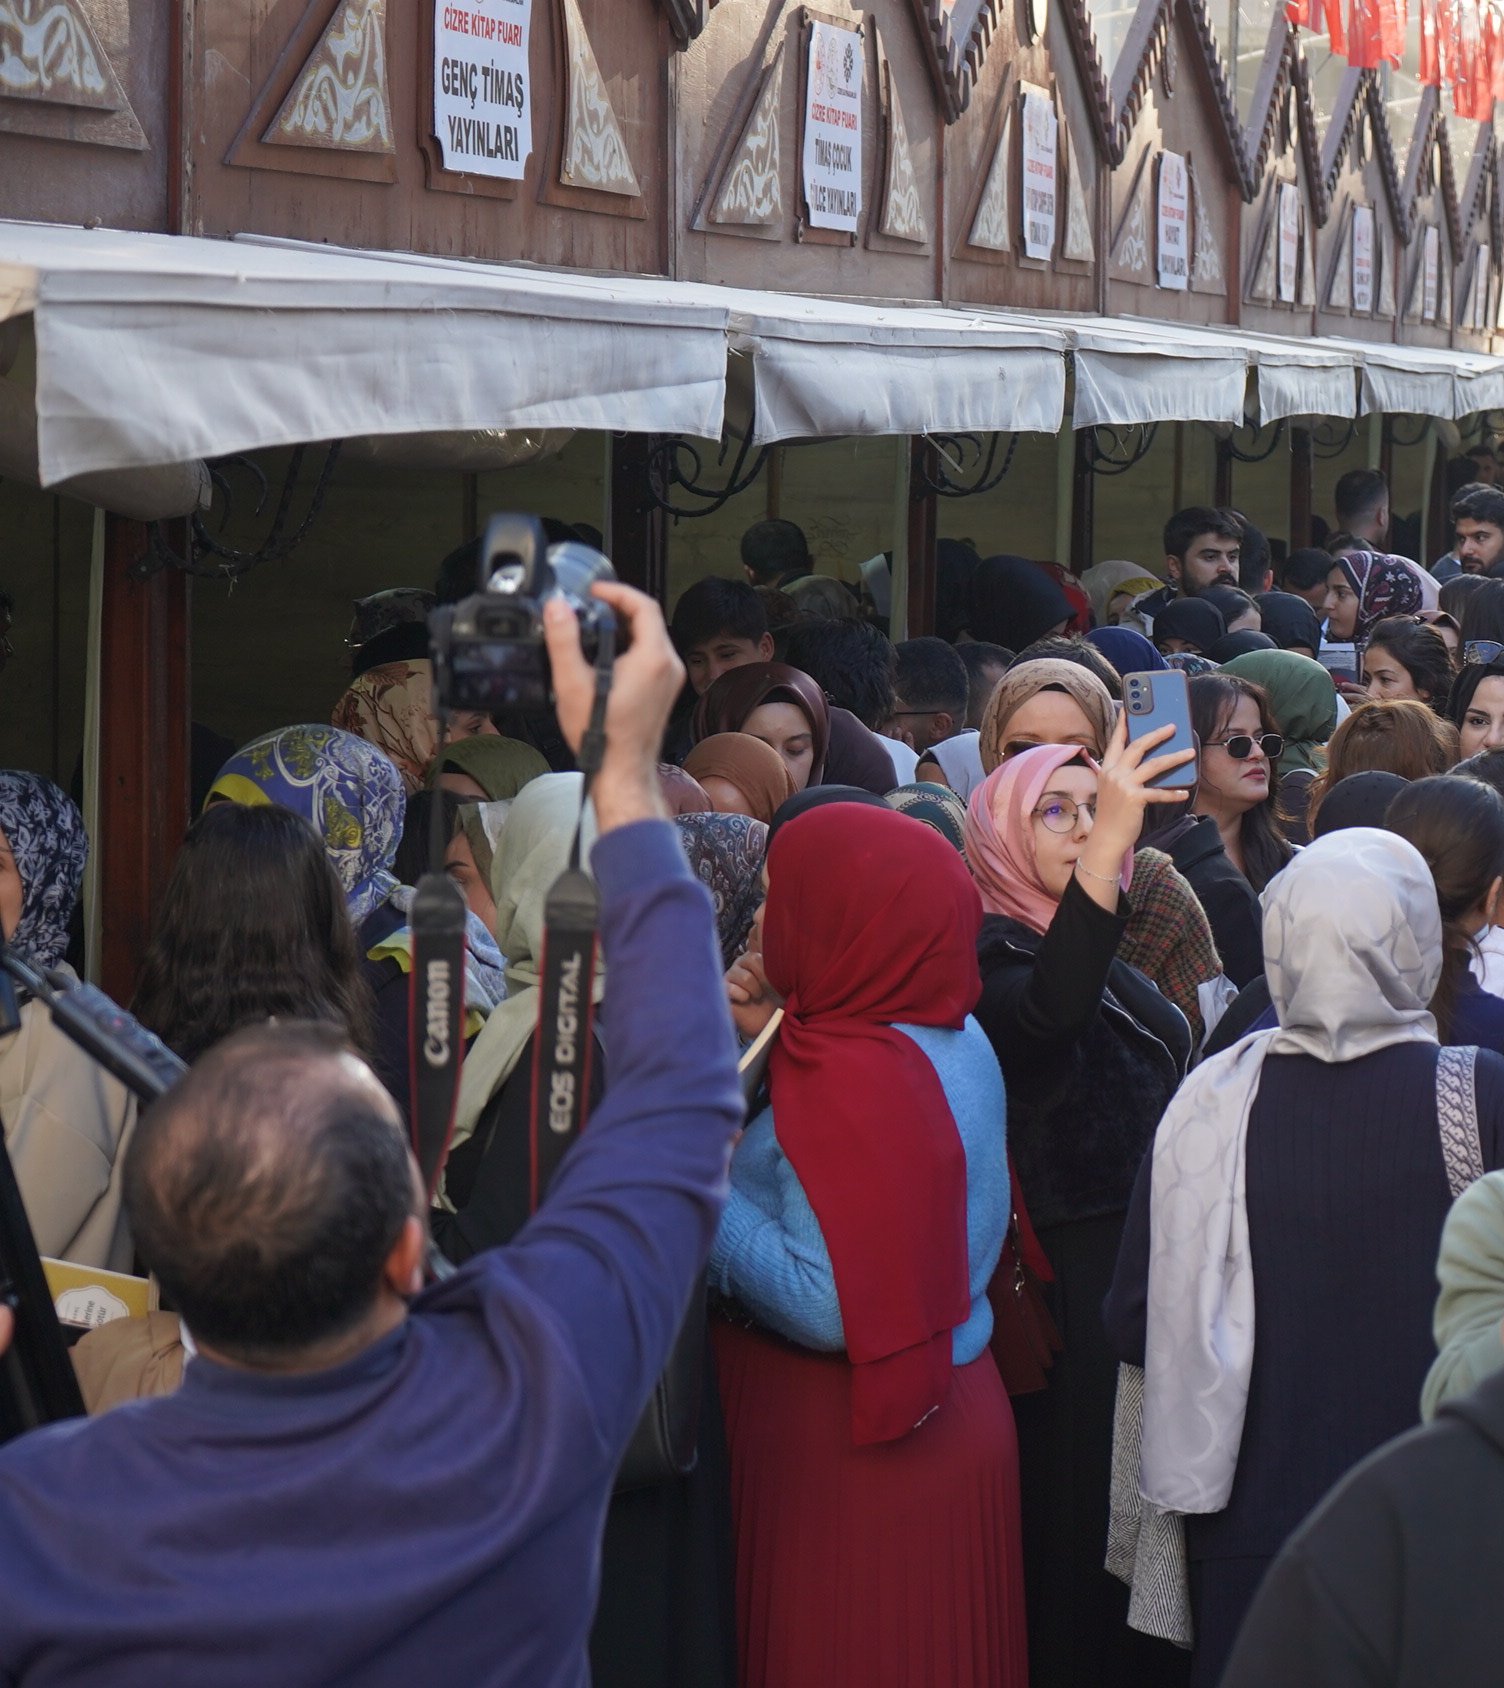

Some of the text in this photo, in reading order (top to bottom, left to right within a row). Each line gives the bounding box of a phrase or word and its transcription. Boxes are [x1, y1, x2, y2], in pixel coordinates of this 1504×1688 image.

[444, 3, 523, 47] CİZRE KİTAP FUARI
[441, 56, 524, 118] GENÇ TİMAŞ
[448, 114, 520, 162] YAYINLARI
[424, 960, 450, 1067] Canon
[550, 953, 581, 1133] EOS DIGITAL
